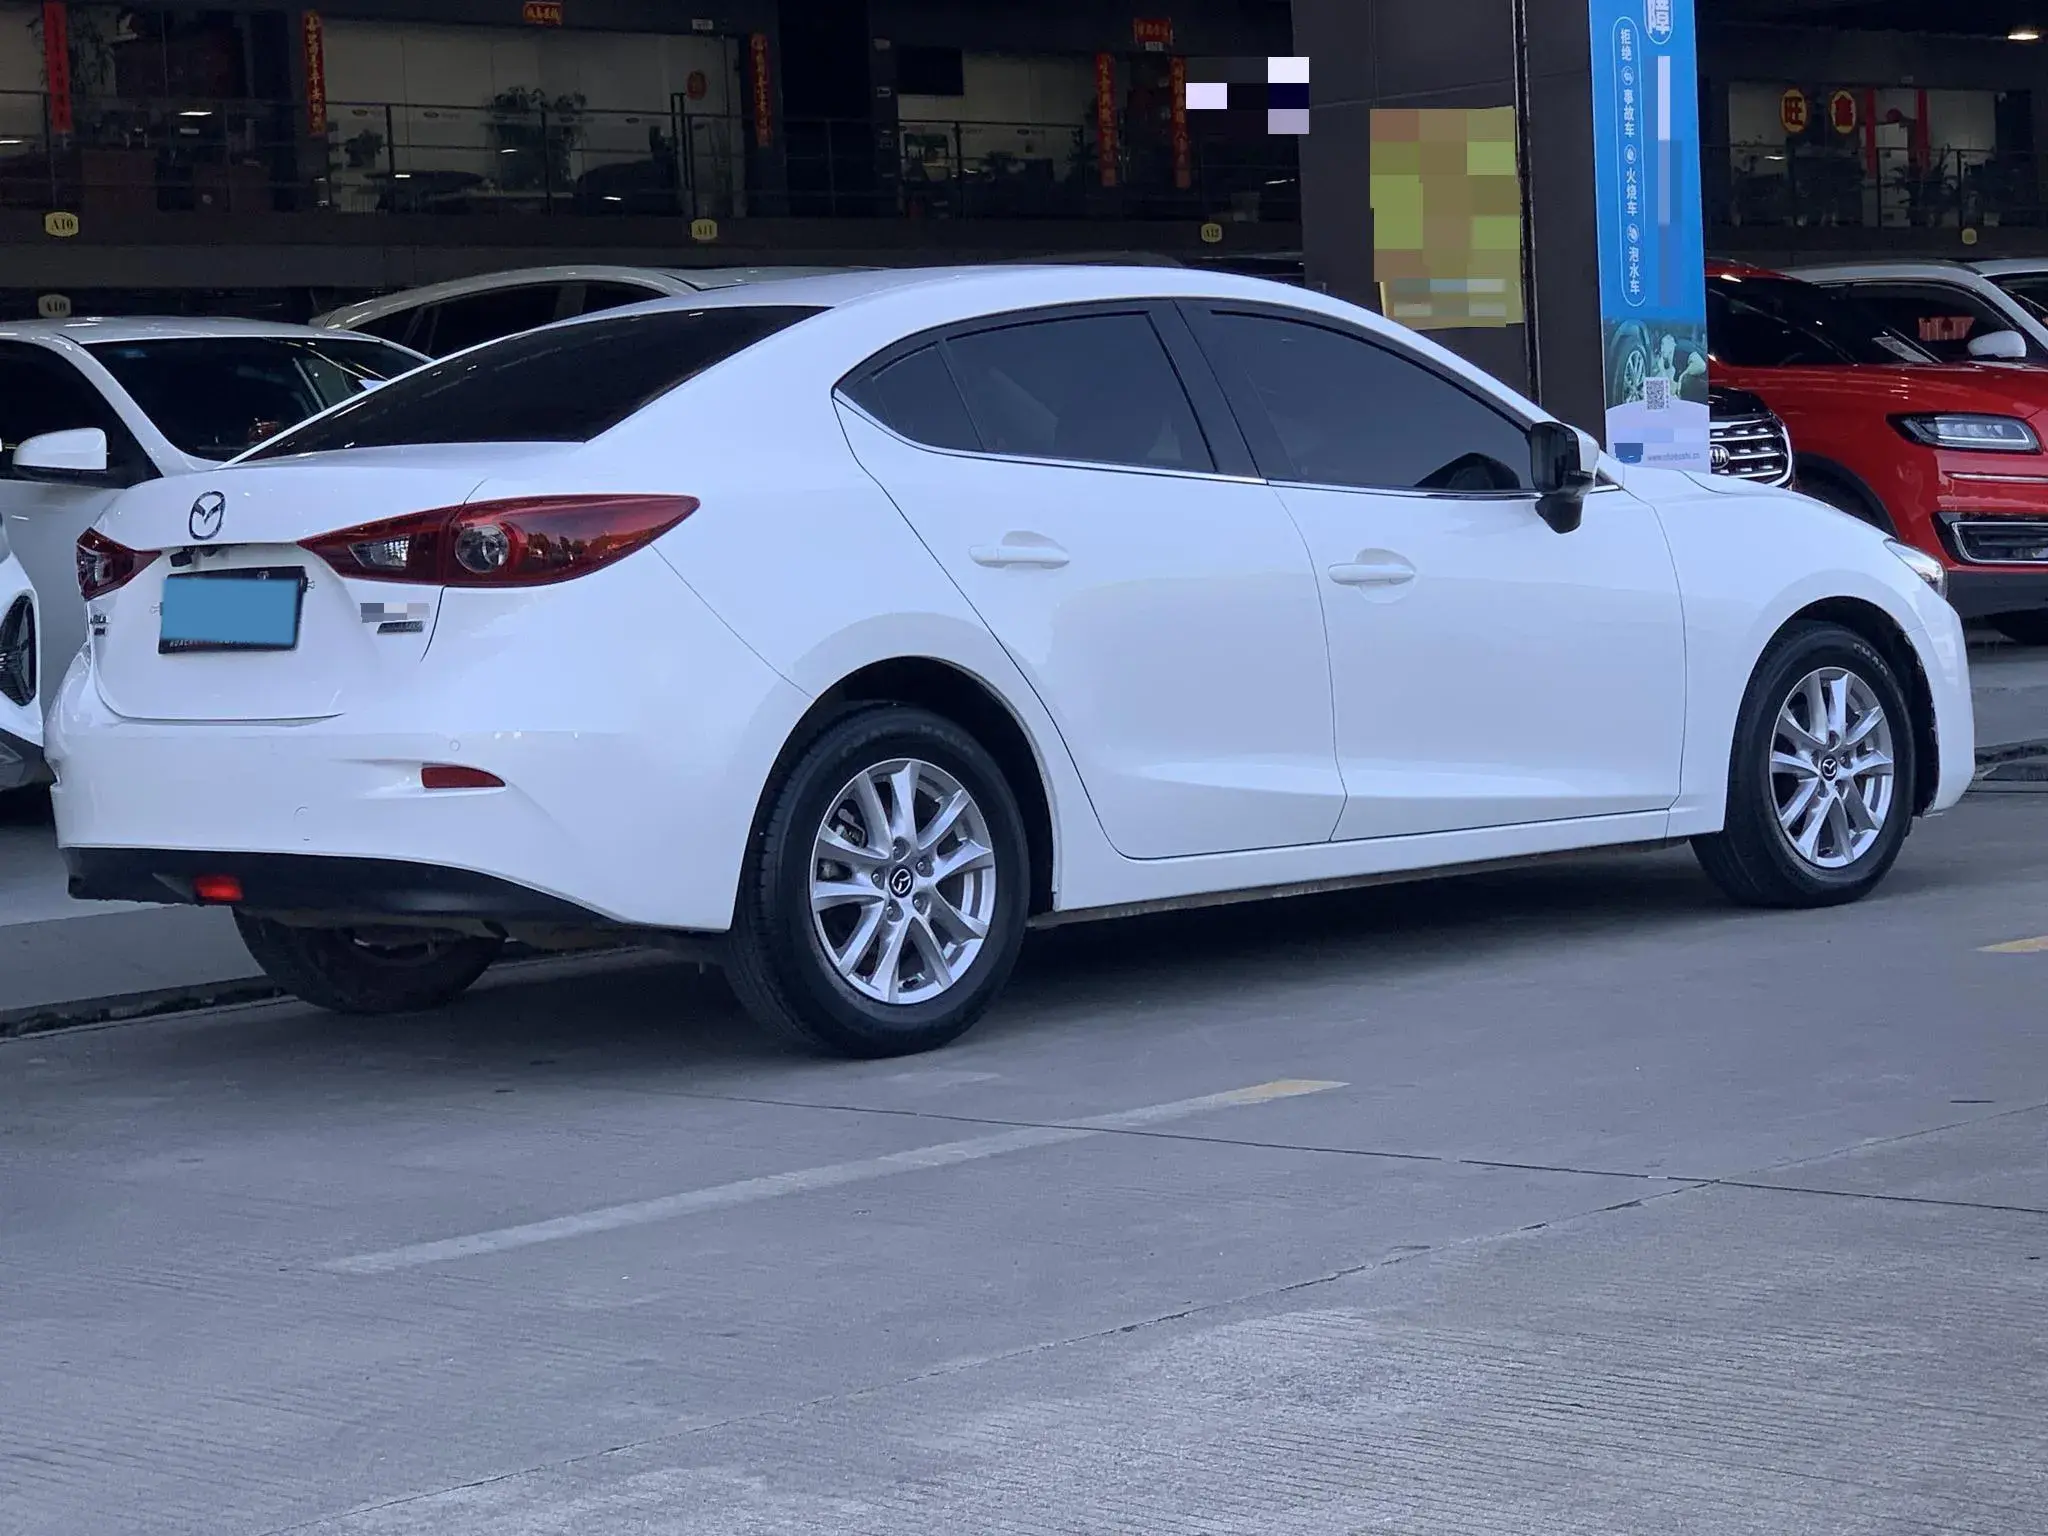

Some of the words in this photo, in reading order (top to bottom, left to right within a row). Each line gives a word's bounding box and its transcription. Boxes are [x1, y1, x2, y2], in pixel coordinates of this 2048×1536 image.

[1620, 28, 1632, 61] 拒绝
[1623, 89, 1635, 138] 事故车
[1626, 167, 1638, 216] 火烧车
[51, 217, 74, 231] A10
[695, 223, 714, 236] A11
[1628, 246, 1640, 295] 泡水车
